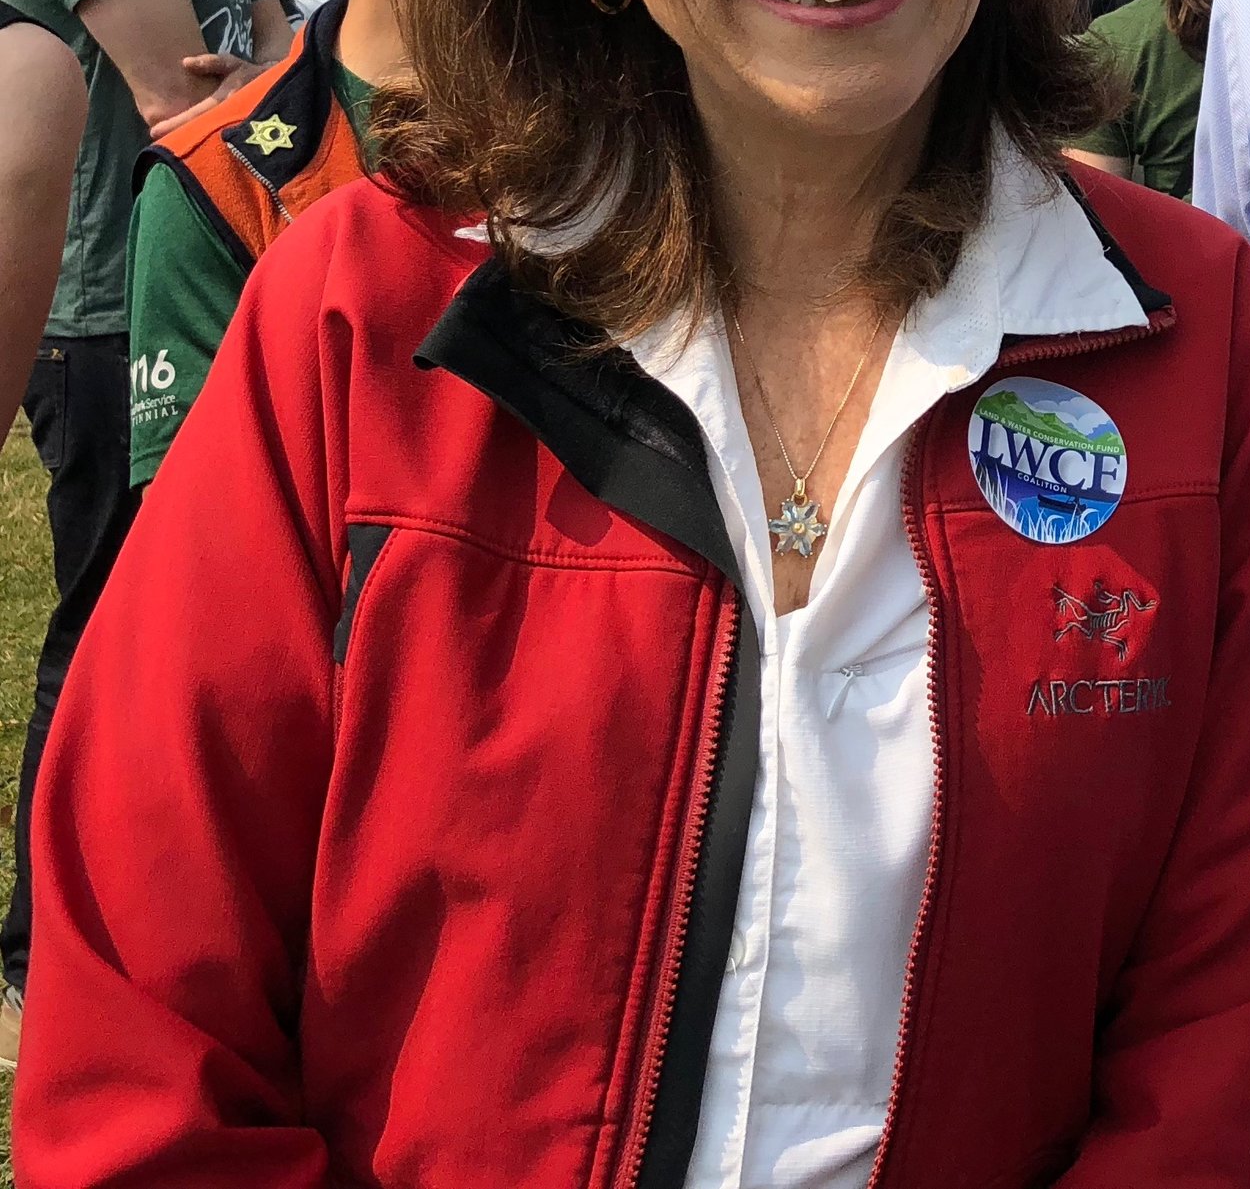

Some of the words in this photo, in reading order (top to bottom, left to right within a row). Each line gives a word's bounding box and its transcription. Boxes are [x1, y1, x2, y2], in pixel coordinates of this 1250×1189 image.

[979, 408, 999, 423] LAND
[1008, 419, 1032, 436] WATER
[1033, 430, 1094, 451] CONSERVATION
[1096, 443, 1120, 454] FUND
[977, 415, 1121, 494] LWCF
[1017, 472, 1068, 494] COALITION
